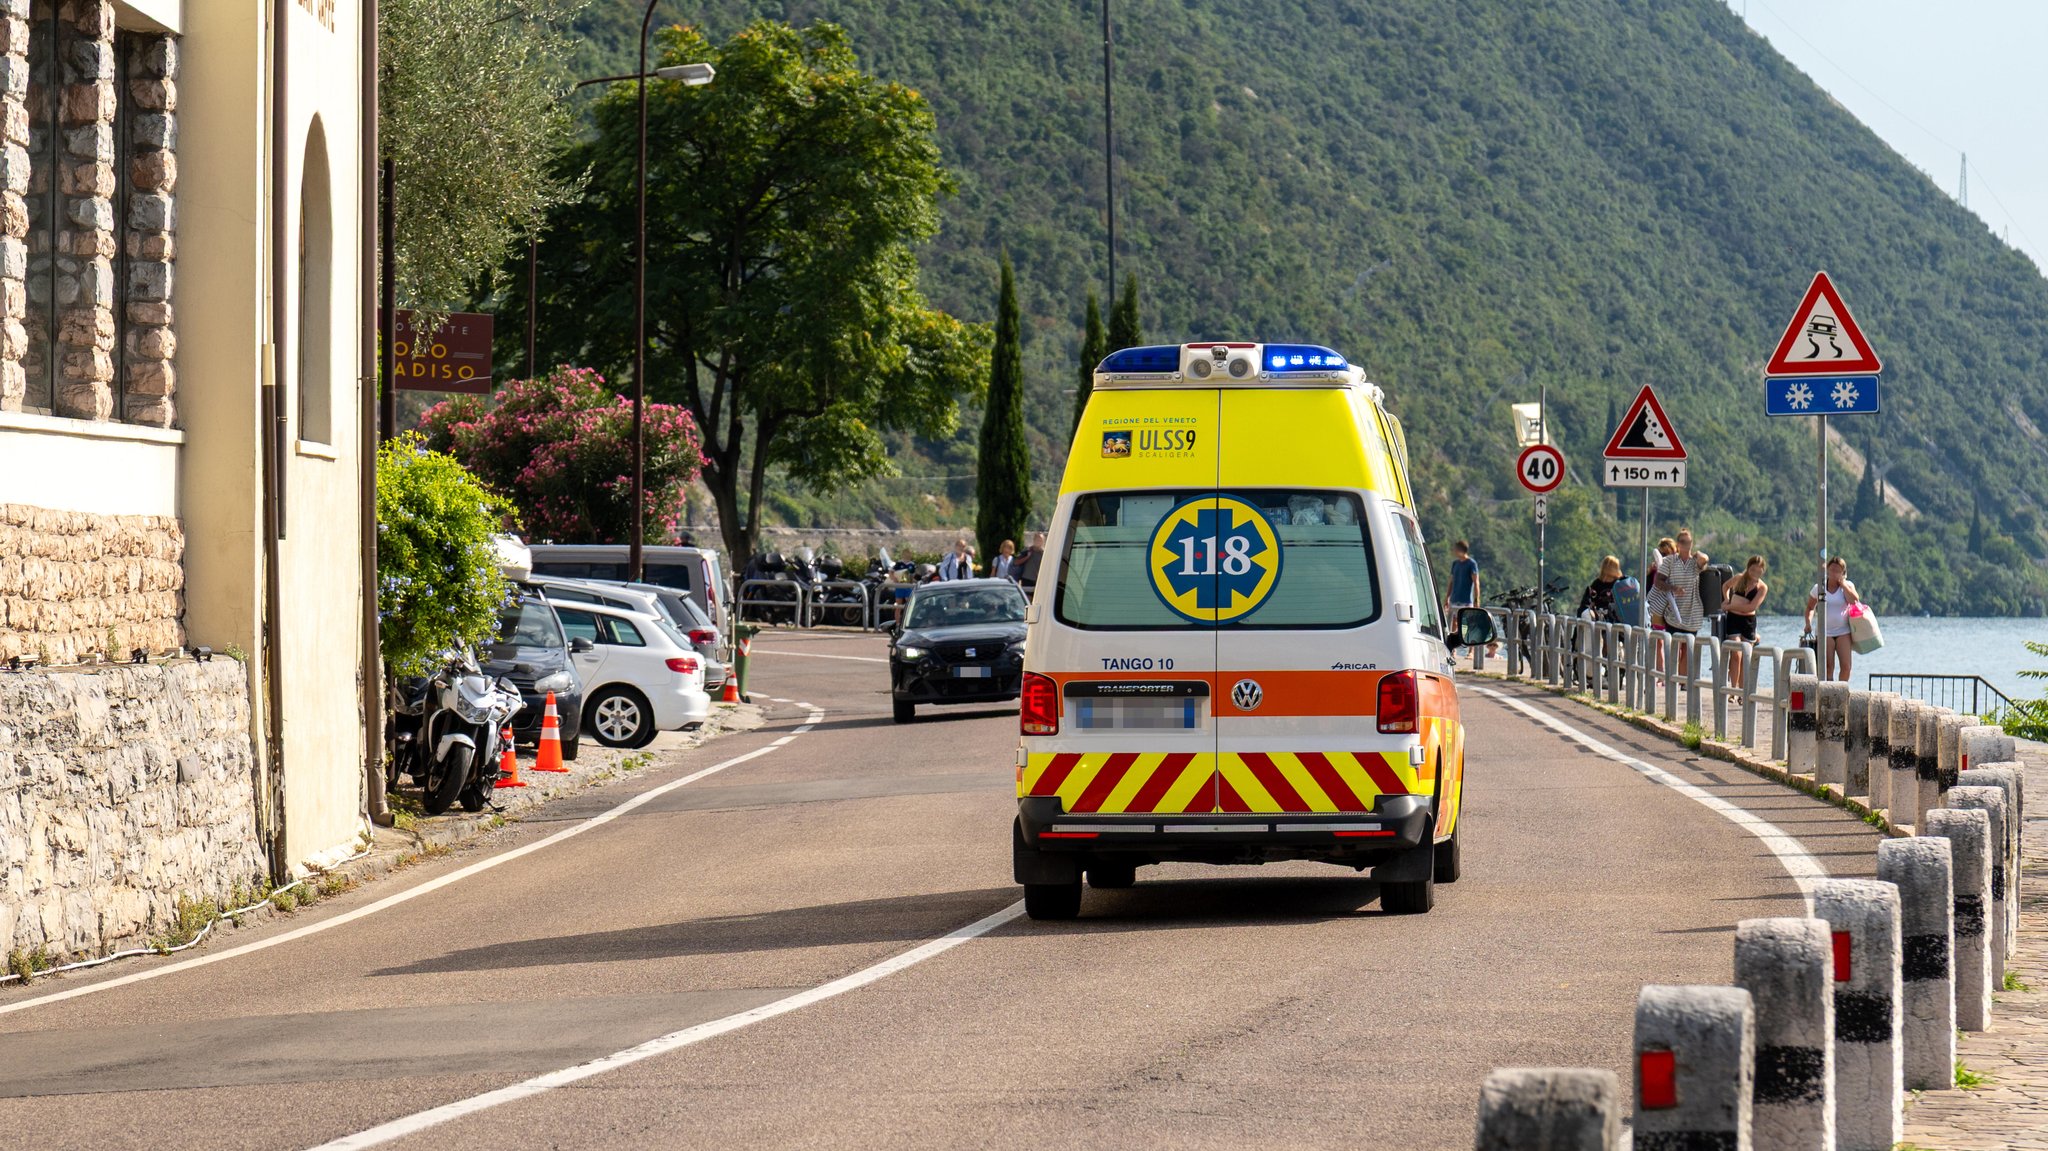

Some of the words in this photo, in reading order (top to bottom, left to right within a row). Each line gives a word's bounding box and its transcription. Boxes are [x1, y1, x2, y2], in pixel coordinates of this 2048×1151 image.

[395, 322, 469, 335] ORANTE
[394, 361, 475, 380] ADISO
[1139, 429, 1196, 451] ULSS9
[1527, 457, 1555, 480] 40
[1623, 467, 1650, 480] 150
[1654, 470, 1667, 480] m
[1178, 535, 1252, 576] 118
[1101, 657, 1154, 670] TANGO
[1158, 658, 1174, 670] 10
[1097, 685, 1174, 693] TRANSPORTER
